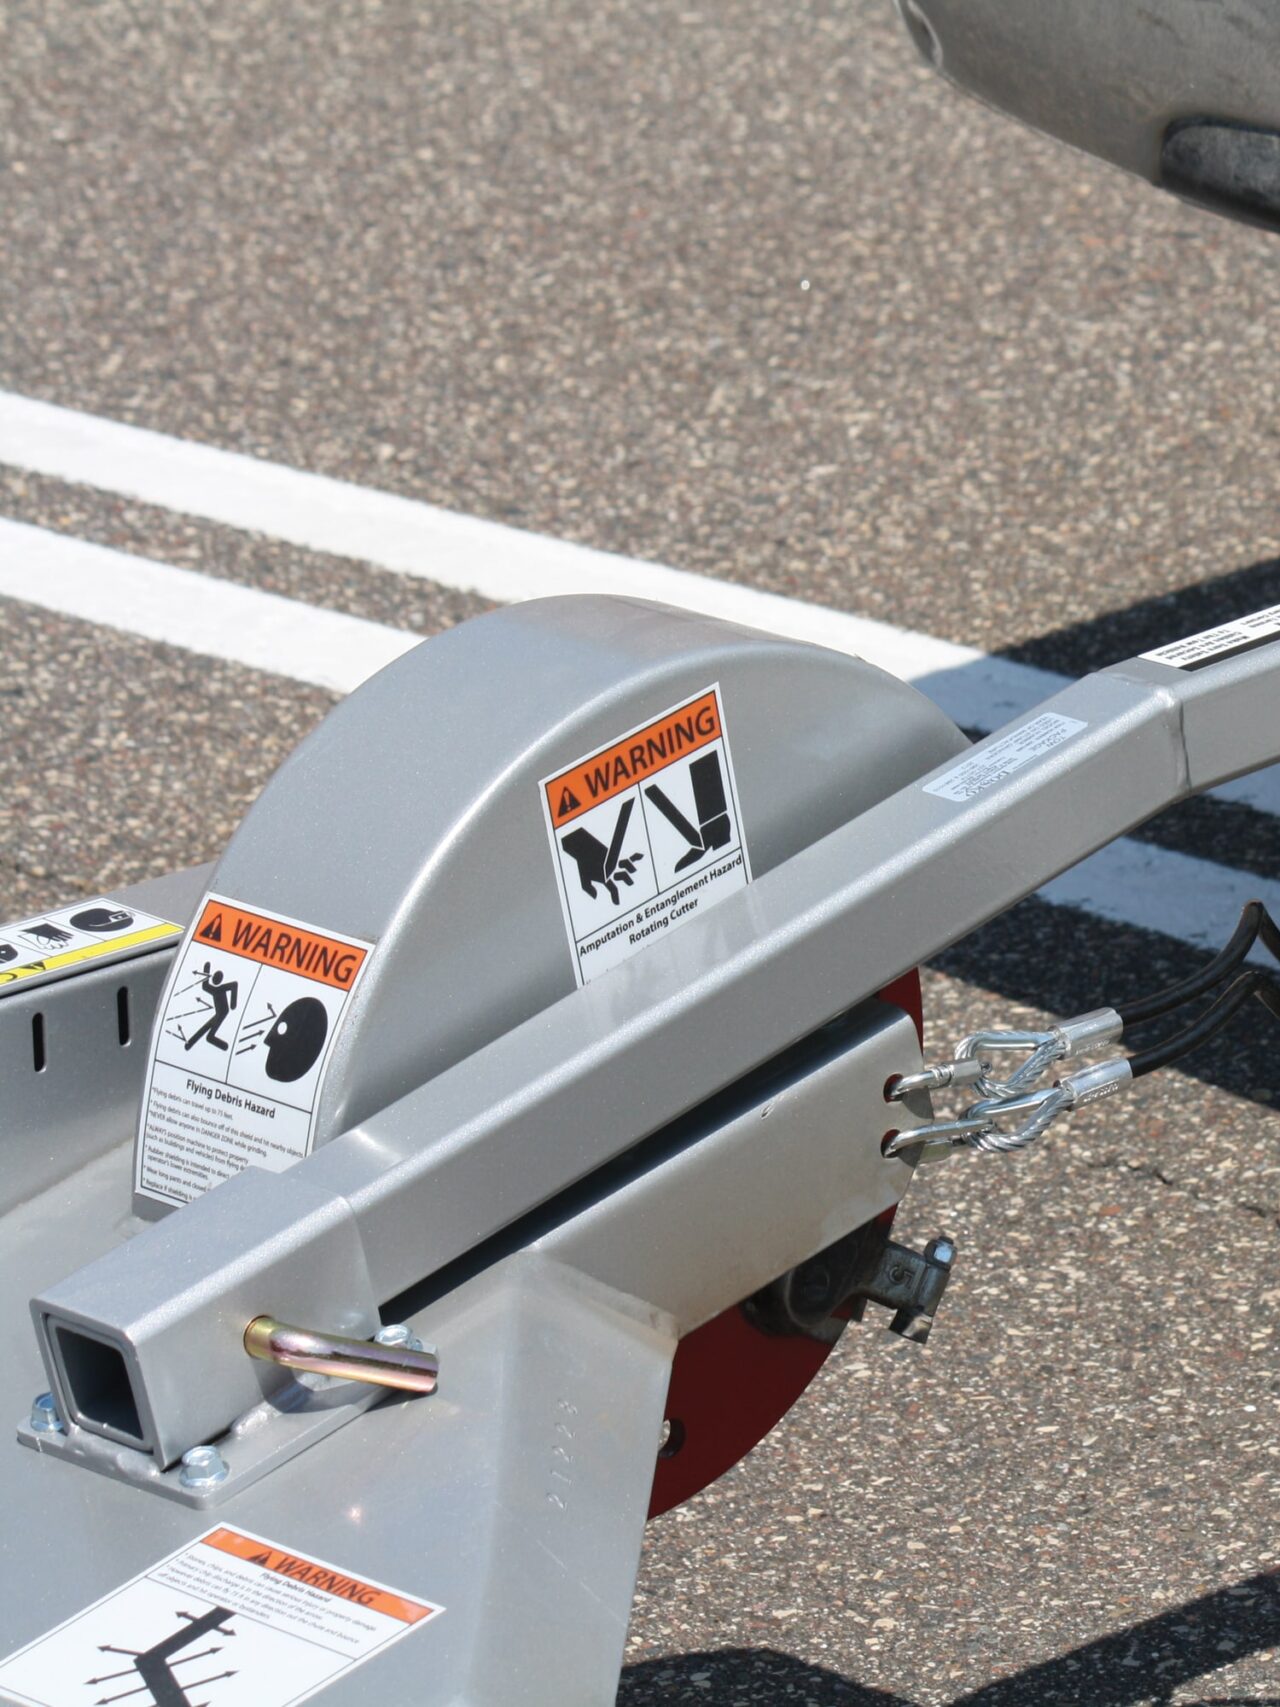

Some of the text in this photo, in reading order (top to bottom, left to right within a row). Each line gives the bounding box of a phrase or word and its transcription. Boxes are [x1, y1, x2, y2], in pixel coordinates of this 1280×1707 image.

[584, 705, 716, 798] WARNING
[580, 854, 743, 957] Amputation & Entanglement Hazard
[628, 898, 699, 945] Rotating Cutter
[232, 918, 357, 984] WARNING
[186, 1078, 275, 1118] Flying Debris Hazard
[275, 1555, 382, 1606] WARNING
